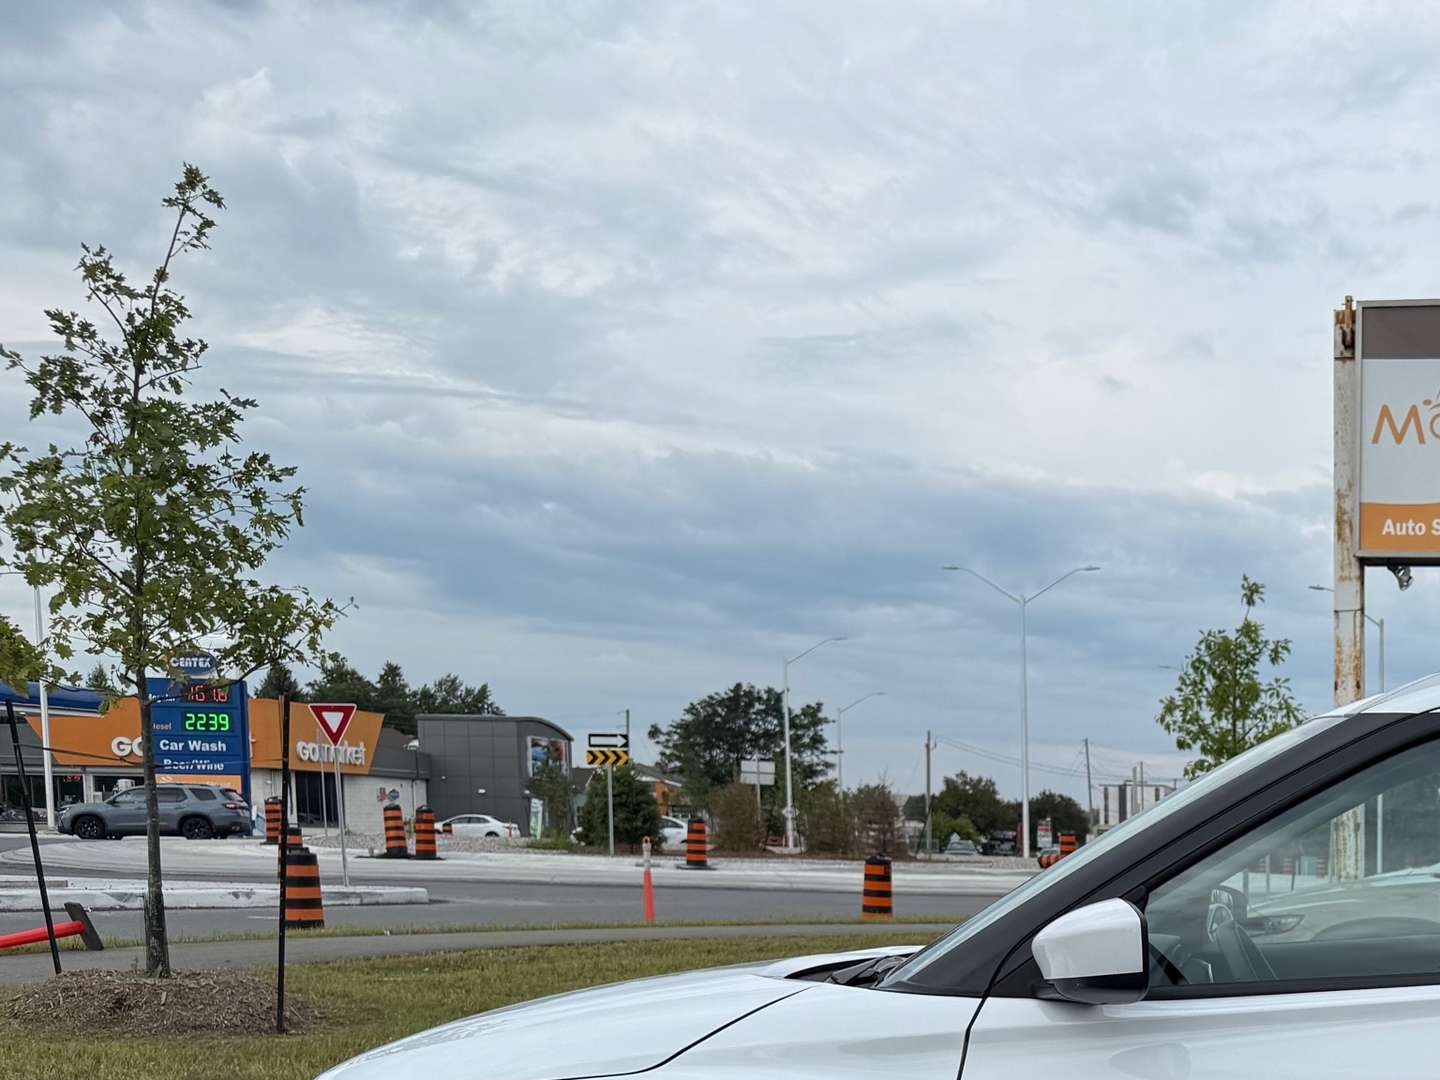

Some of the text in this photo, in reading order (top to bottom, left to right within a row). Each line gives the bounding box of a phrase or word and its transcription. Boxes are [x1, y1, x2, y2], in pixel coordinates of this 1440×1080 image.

[1381, 518, 1426, 536] Auto
[159, 739, 227, 752] Car Wash
